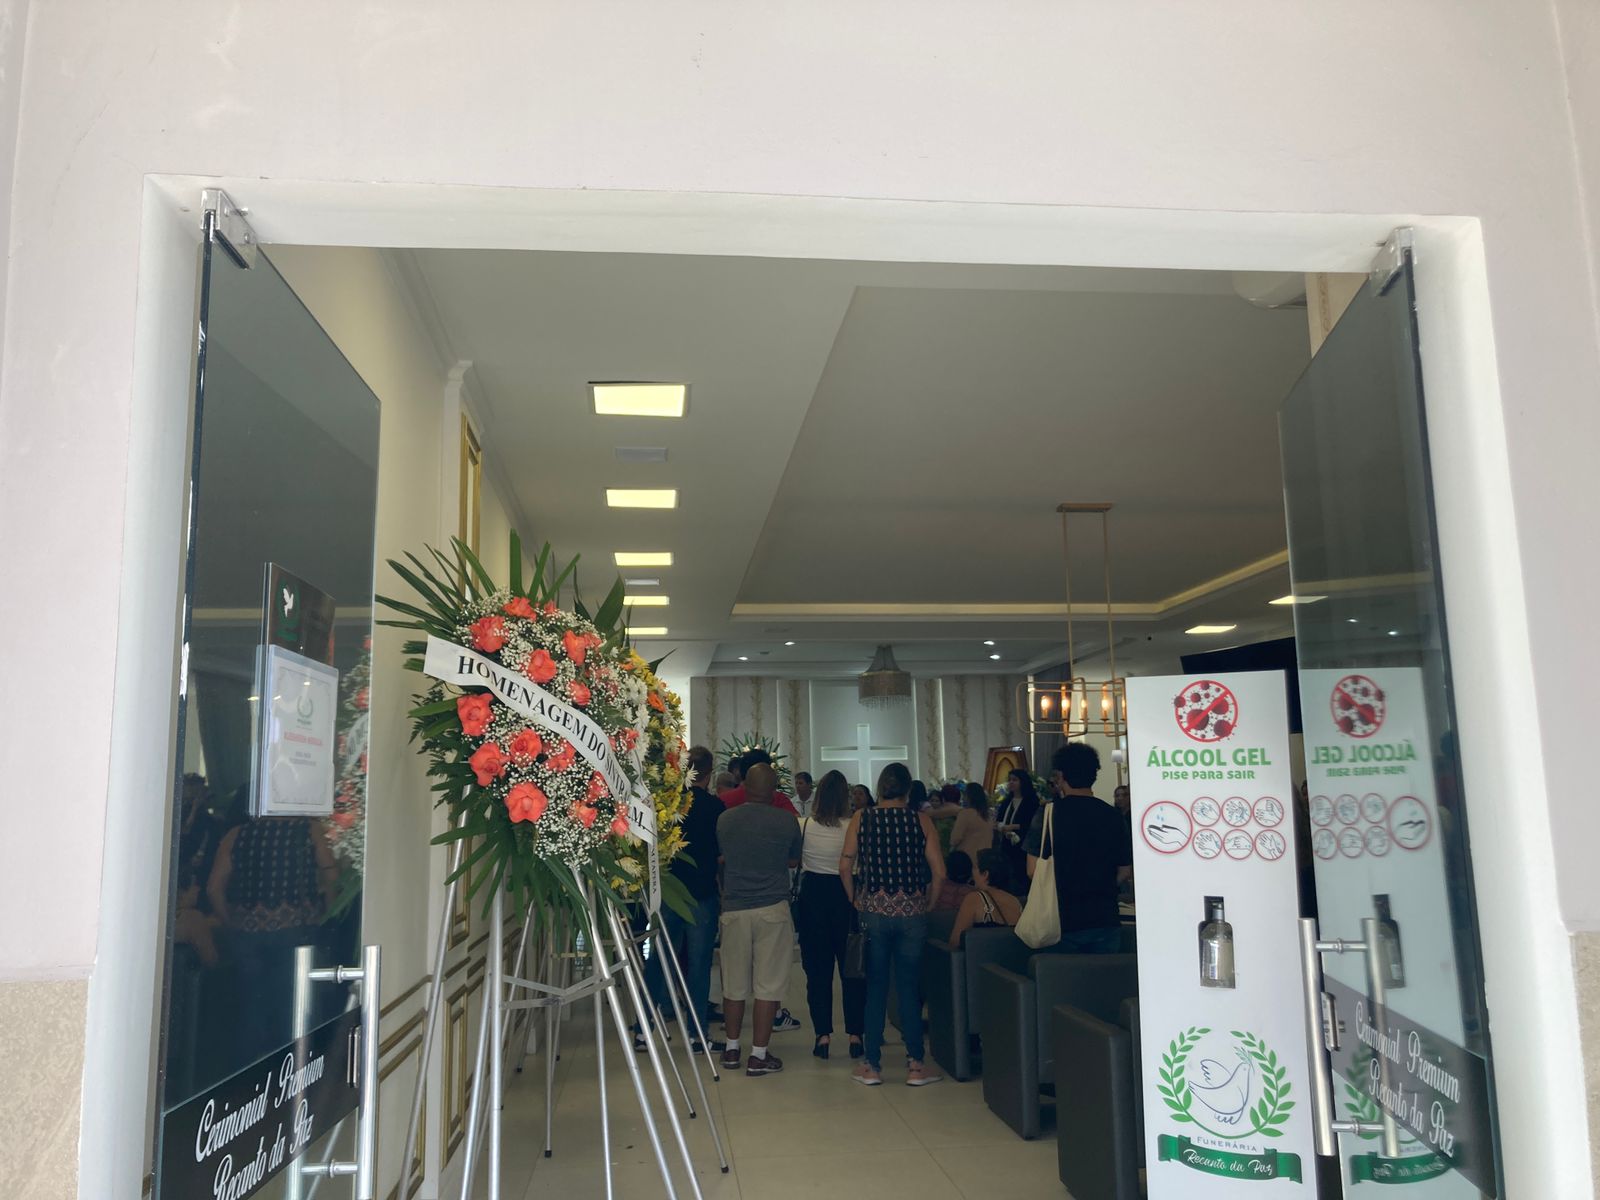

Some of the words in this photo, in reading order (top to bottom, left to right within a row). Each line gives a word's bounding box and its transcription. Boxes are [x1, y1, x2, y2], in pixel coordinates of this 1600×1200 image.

[458, 656, 587, 742] HOMENAGEM
[587, 732, 606, 760] DO
[1147, 746, 1227, 767] ÁLCOOL
[1232, 748, 1271, 766] GEL
[1355, 1001, 1400, 1064] Cerimonial
[1406, 1031, 1460, 1103] Premium
[195, 1071, 272, 1163] Cerimonial
[274, 1051, 324, 1108] Premium
[213, 1136, 268, 1200] Recanto
[268, 1122, 286, 1172] da
[289, 1099, 314, 1154] Paz
[1368, 1058, 1407, 1121] Recanto
[1409, 1093, 1424, 1134] da
[1428, 1101, 1455, 1158] Paz
[1183, 1148, 1226, 1170] Recanto
[1229, 1160, 1245, 1172] da
[1248, 1159, 1273, 1176] Paz
